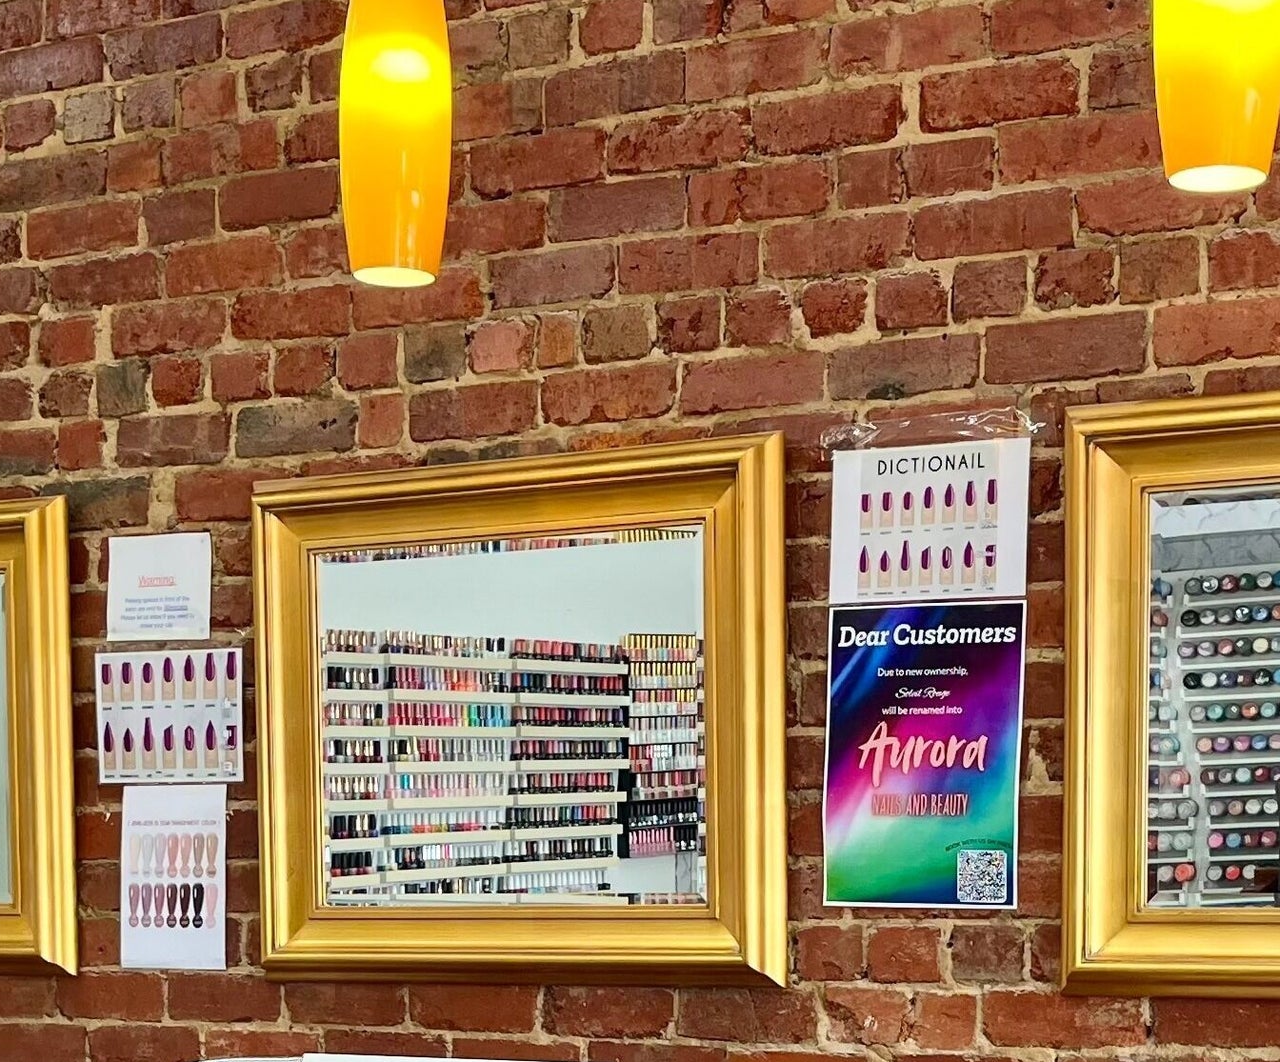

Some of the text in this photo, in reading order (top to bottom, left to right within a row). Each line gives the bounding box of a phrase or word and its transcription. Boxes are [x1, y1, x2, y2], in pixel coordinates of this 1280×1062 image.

[877, 452, 985, 476] DICTIONAIL
[838, 623, 1016, 648] Dear Customers
[877, 667, 894, 677] Due
[895, 668, 904, 677] to
[905, 668, 923, 677] new
[881, 705, 963, 715] will be renamed into
[858, 721, 988, 788] Aurora
[872, 793, 969, 816] NAILS AND BEAUTY
